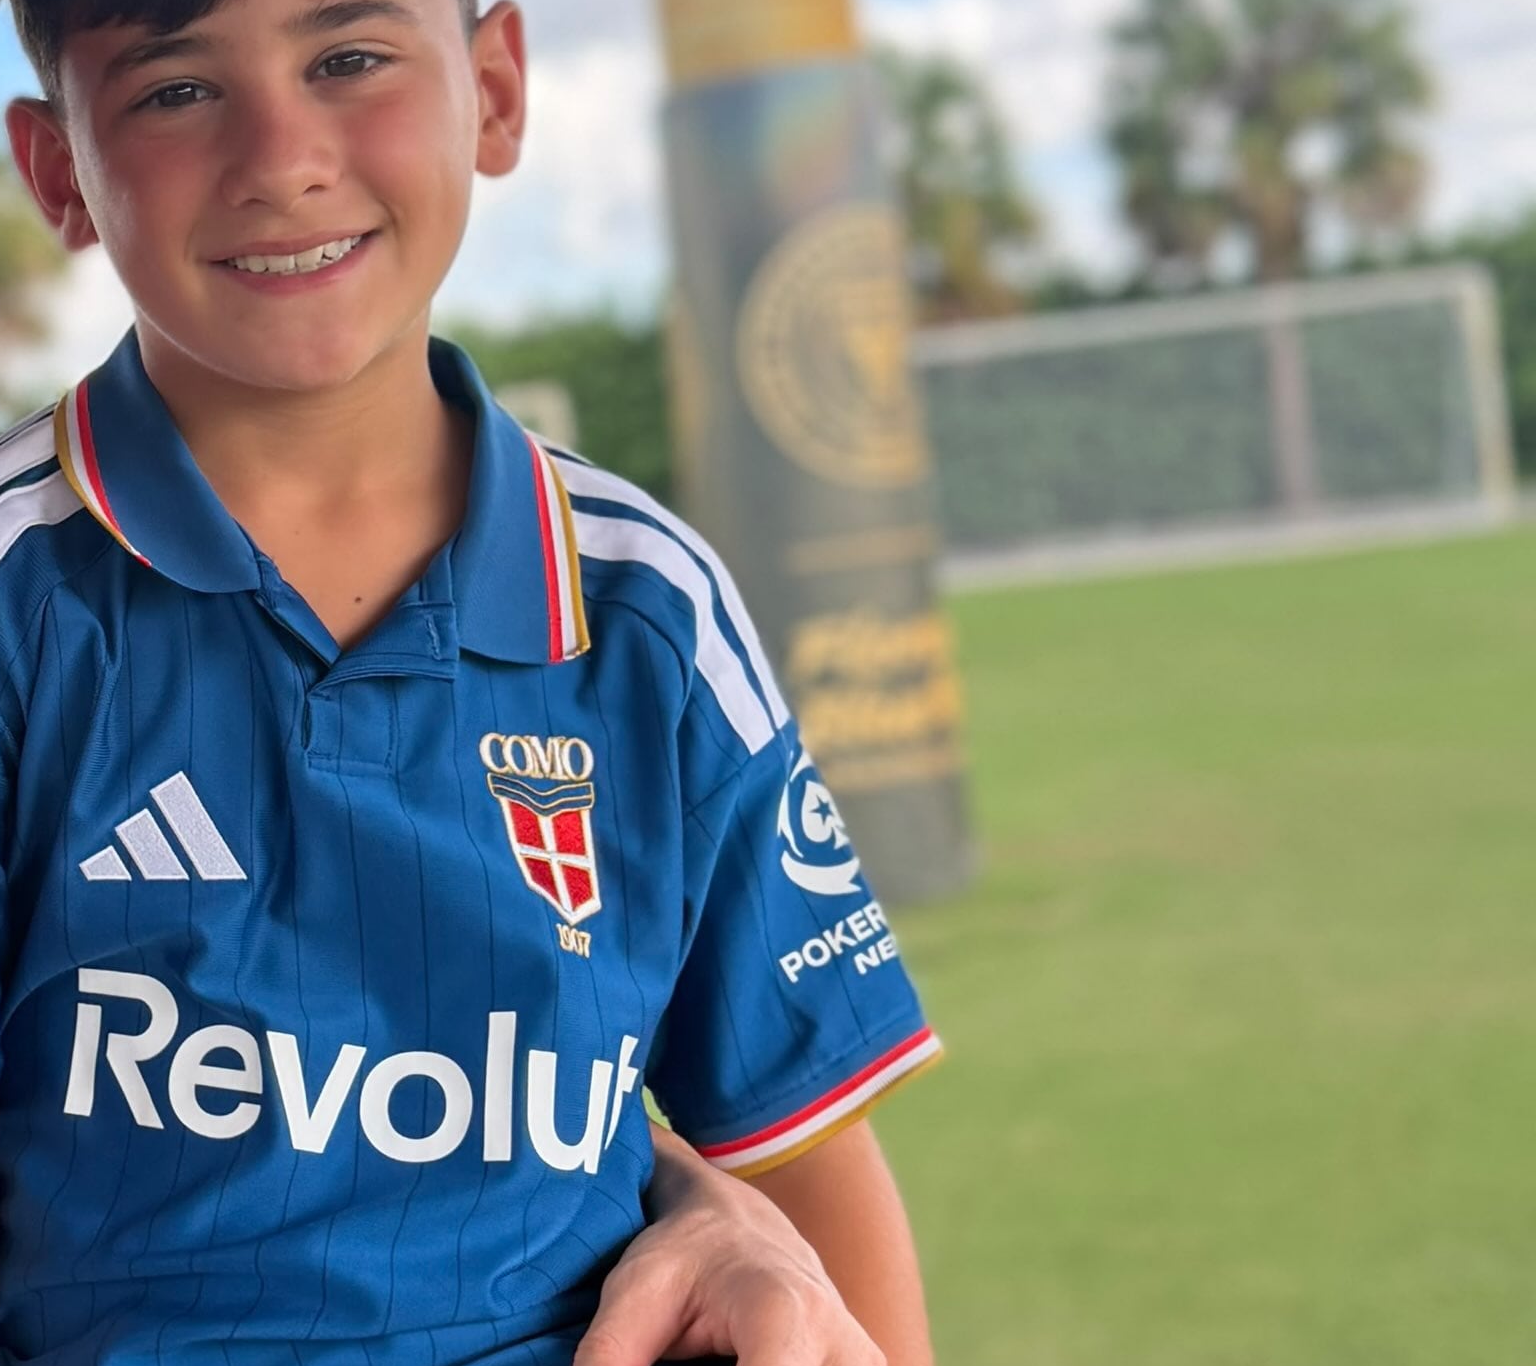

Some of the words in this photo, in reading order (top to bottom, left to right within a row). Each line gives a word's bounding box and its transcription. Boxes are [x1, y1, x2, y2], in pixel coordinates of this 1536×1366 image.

[479, 732, 594, 782] COMO
[556, 923, 592, 958] 1907
[778, 900, 889, 984] POKER
